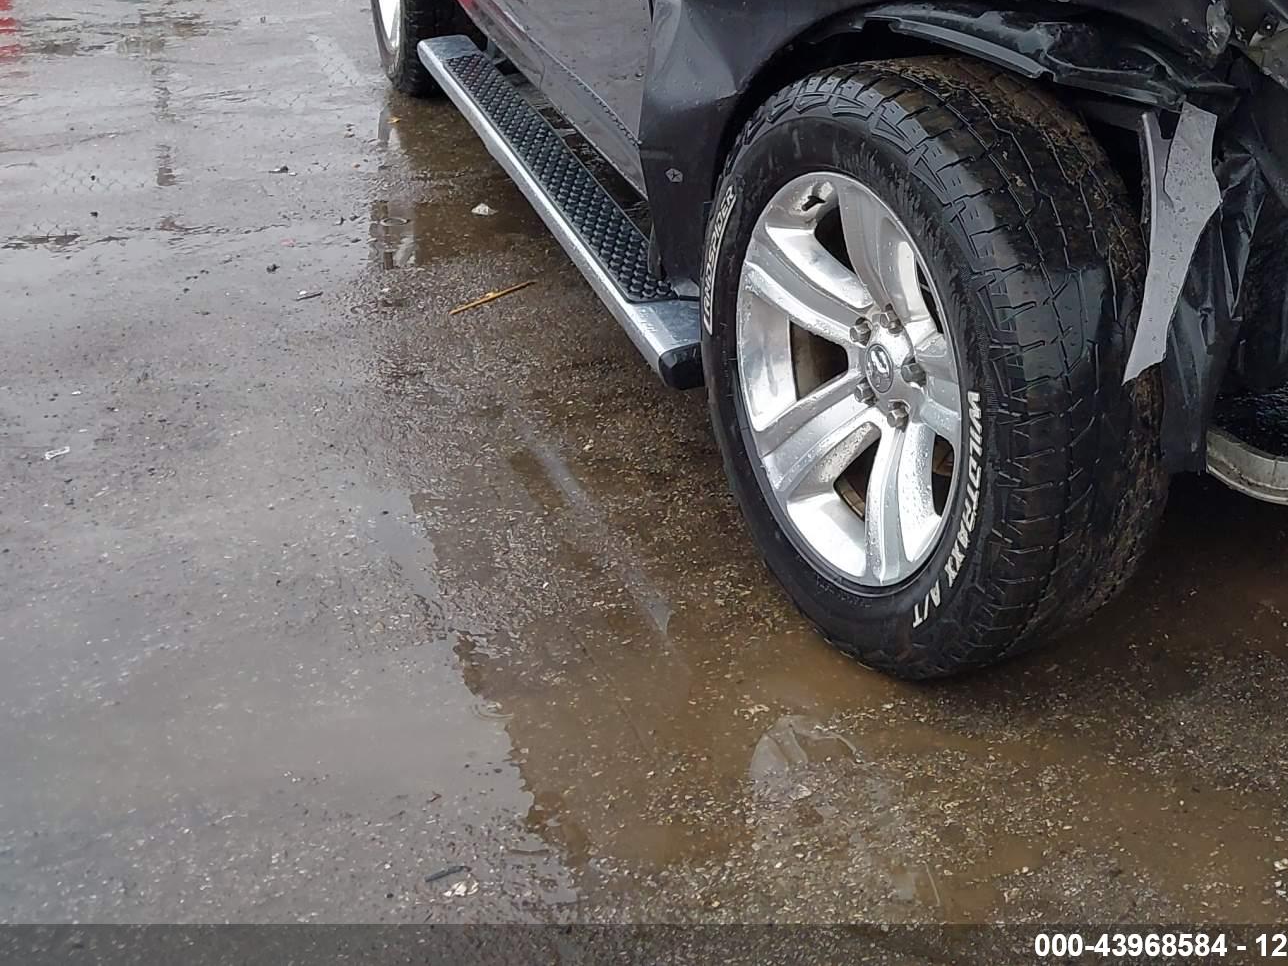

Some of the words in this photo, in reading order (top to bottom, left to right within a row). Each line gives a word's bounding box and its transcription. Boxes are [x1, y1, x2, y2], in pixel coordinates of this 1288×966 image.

[703, 185, 736, 335] LANDSPIDER
[944, 391, 983, 588] WILDTRAXX
[913, 580, 942, 628] A/T
